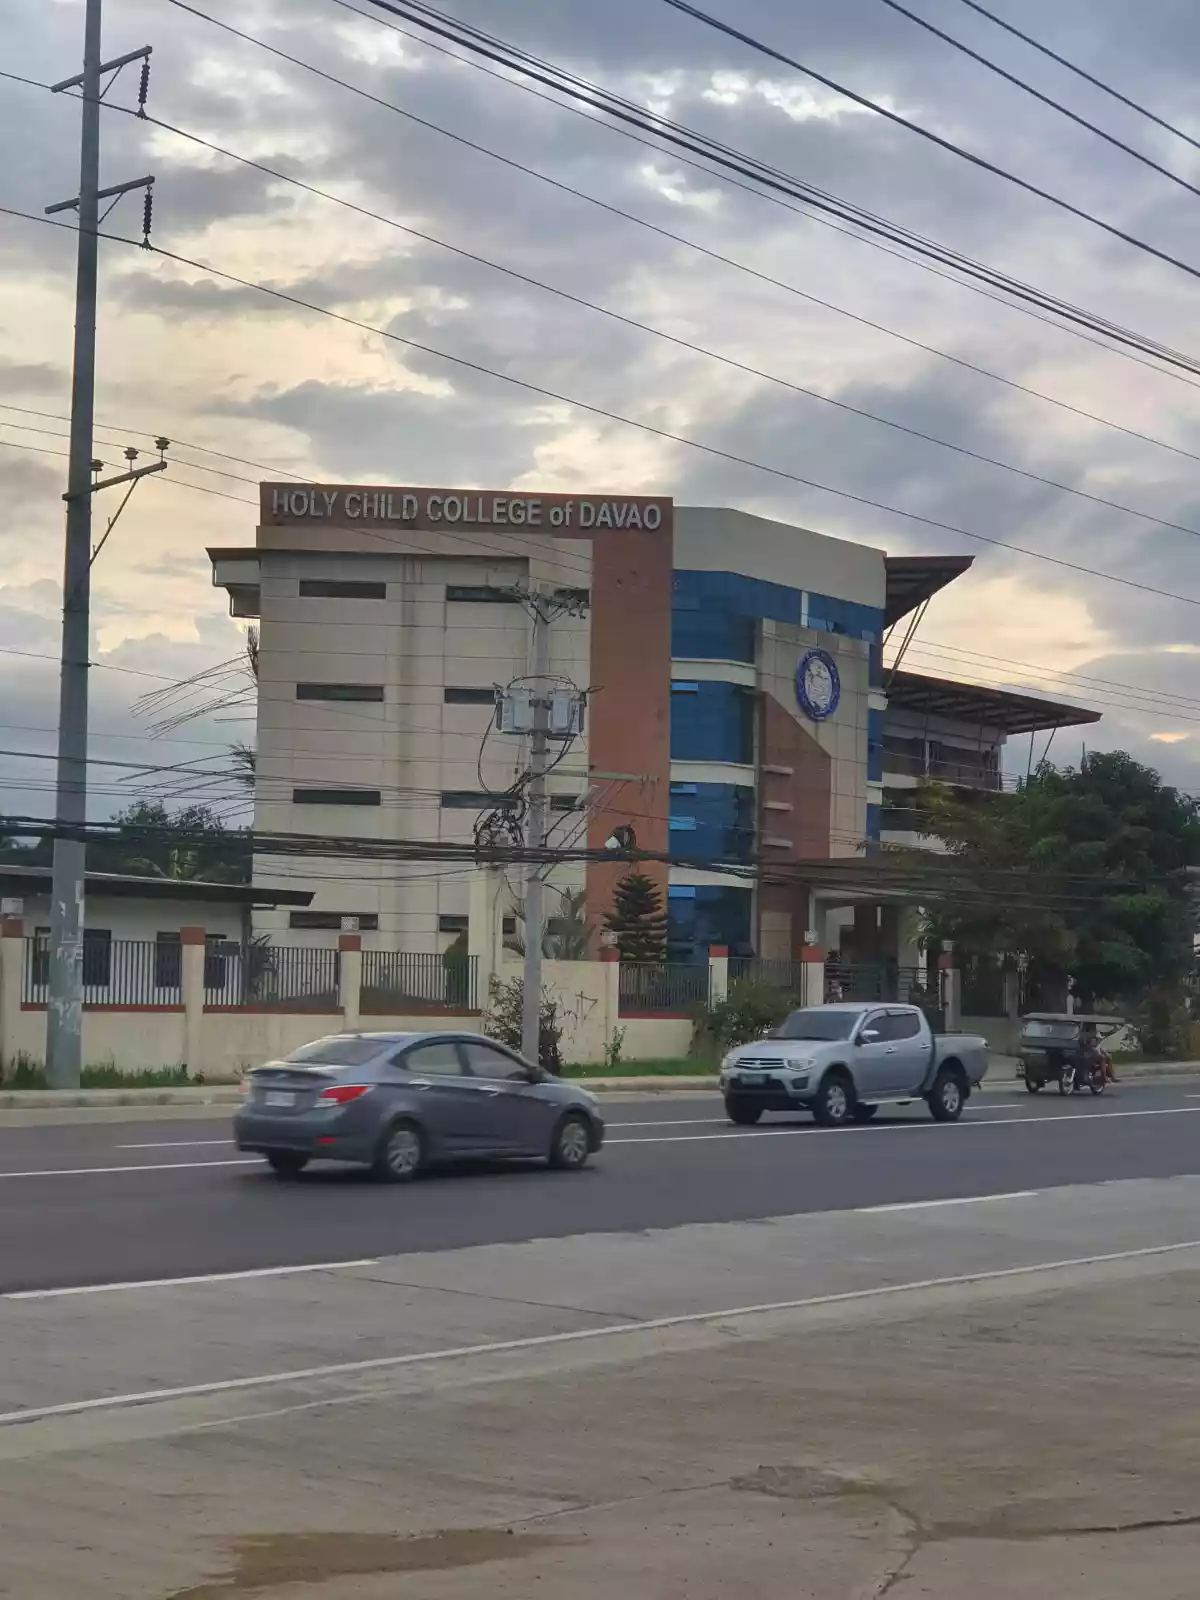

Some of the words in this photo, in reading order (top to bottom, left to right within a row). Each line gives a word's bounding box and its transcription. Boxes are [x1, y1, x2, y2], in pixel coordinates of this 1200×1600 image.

[272, 489, 338, 516] HOLY
[344, 492, 418, 520] CHILD
[426, 495, 542, 525] COLLEGE
[549, 501, 574, 527] of
[579, 501, 662, 530] DAVAO
